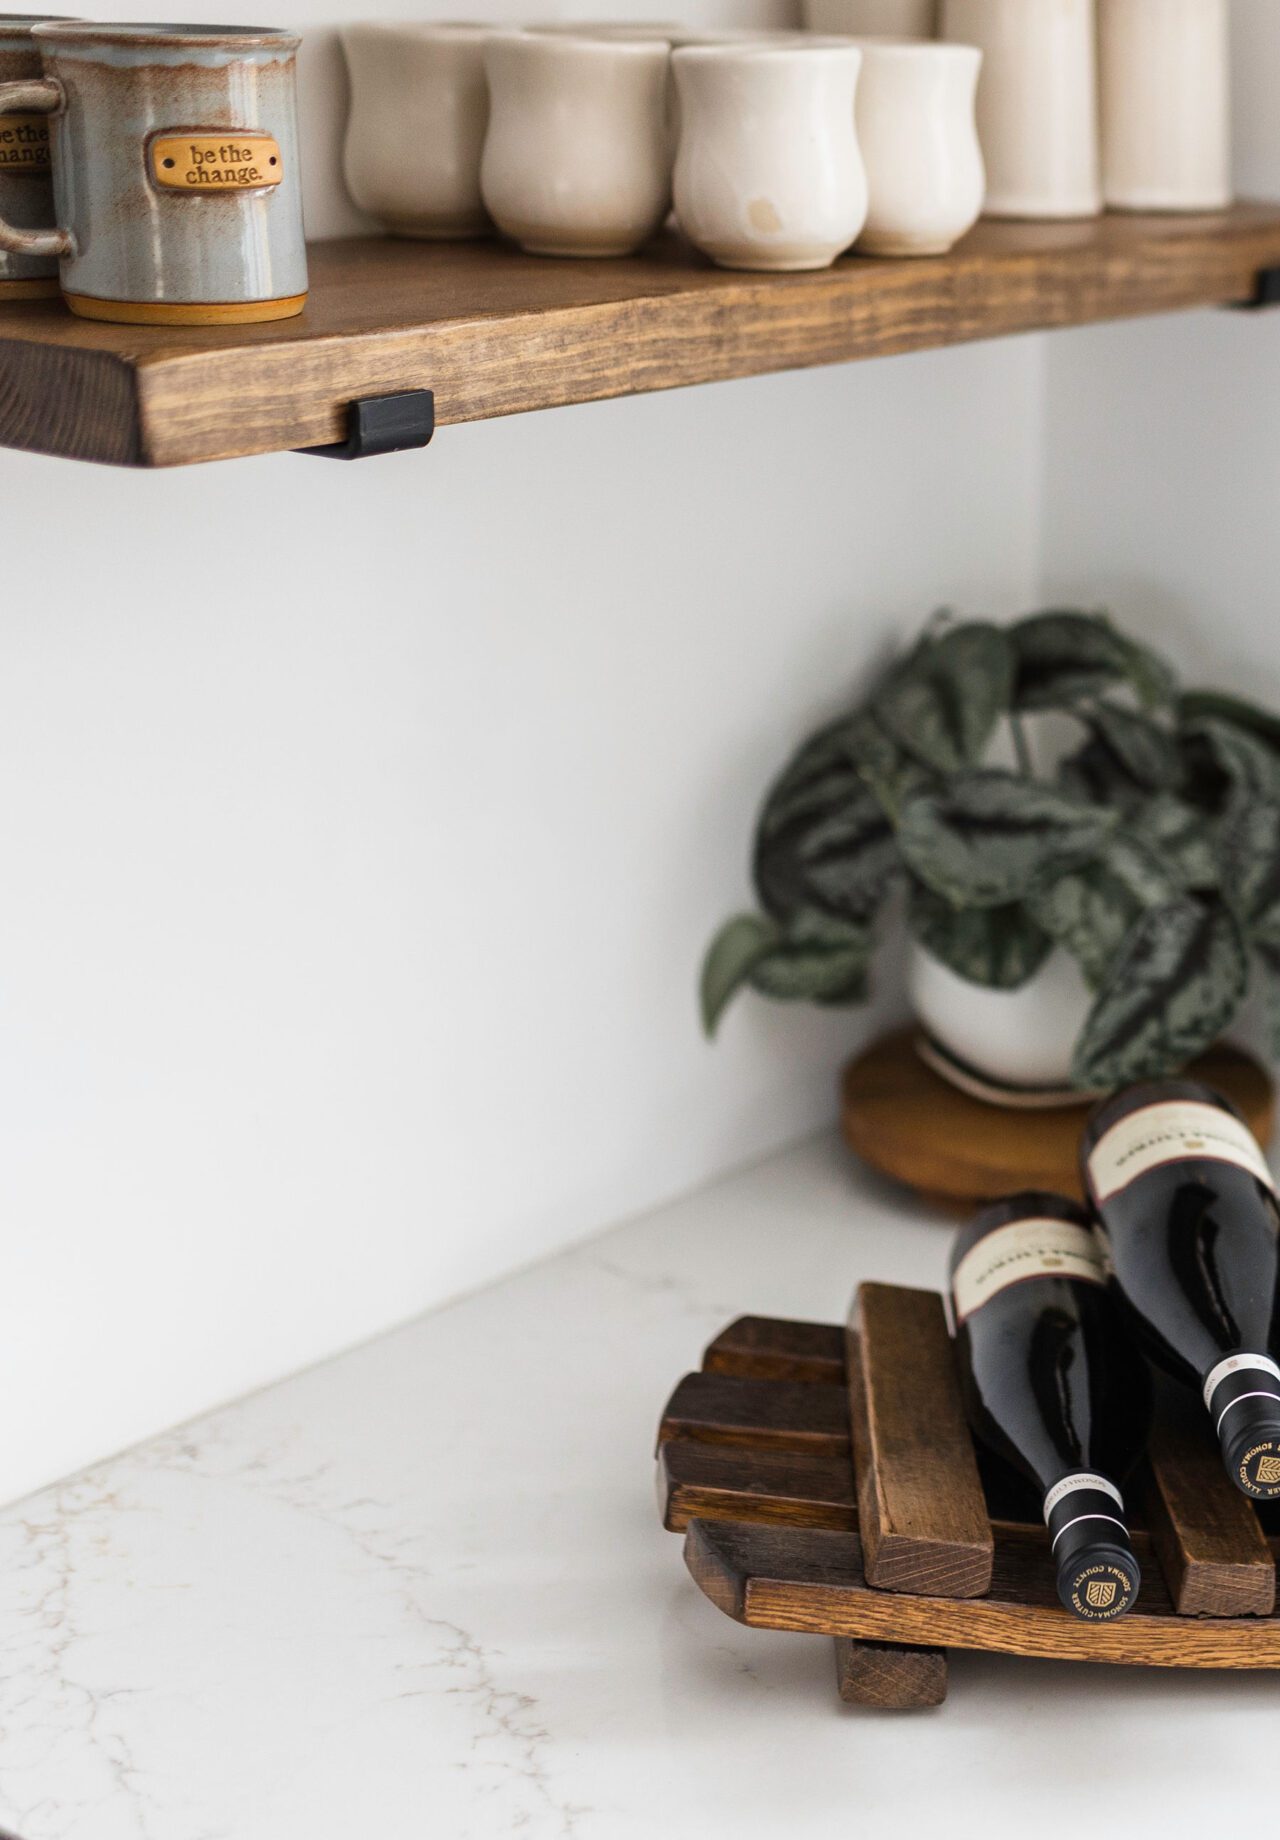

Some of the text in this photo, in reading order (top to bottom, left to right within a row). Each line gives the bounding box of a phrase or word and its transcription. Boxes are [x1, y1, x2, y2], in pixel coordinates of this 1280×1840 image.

[0, 125, 50, 143] e the
[190, 145, 252, 165] be the
[185, 166, 262, 185] change.
[1240, 1442, 1273, 1494] SONOMA COUNTY
[1073, 1565, 1131, 1592] SONOMA COUNTY
